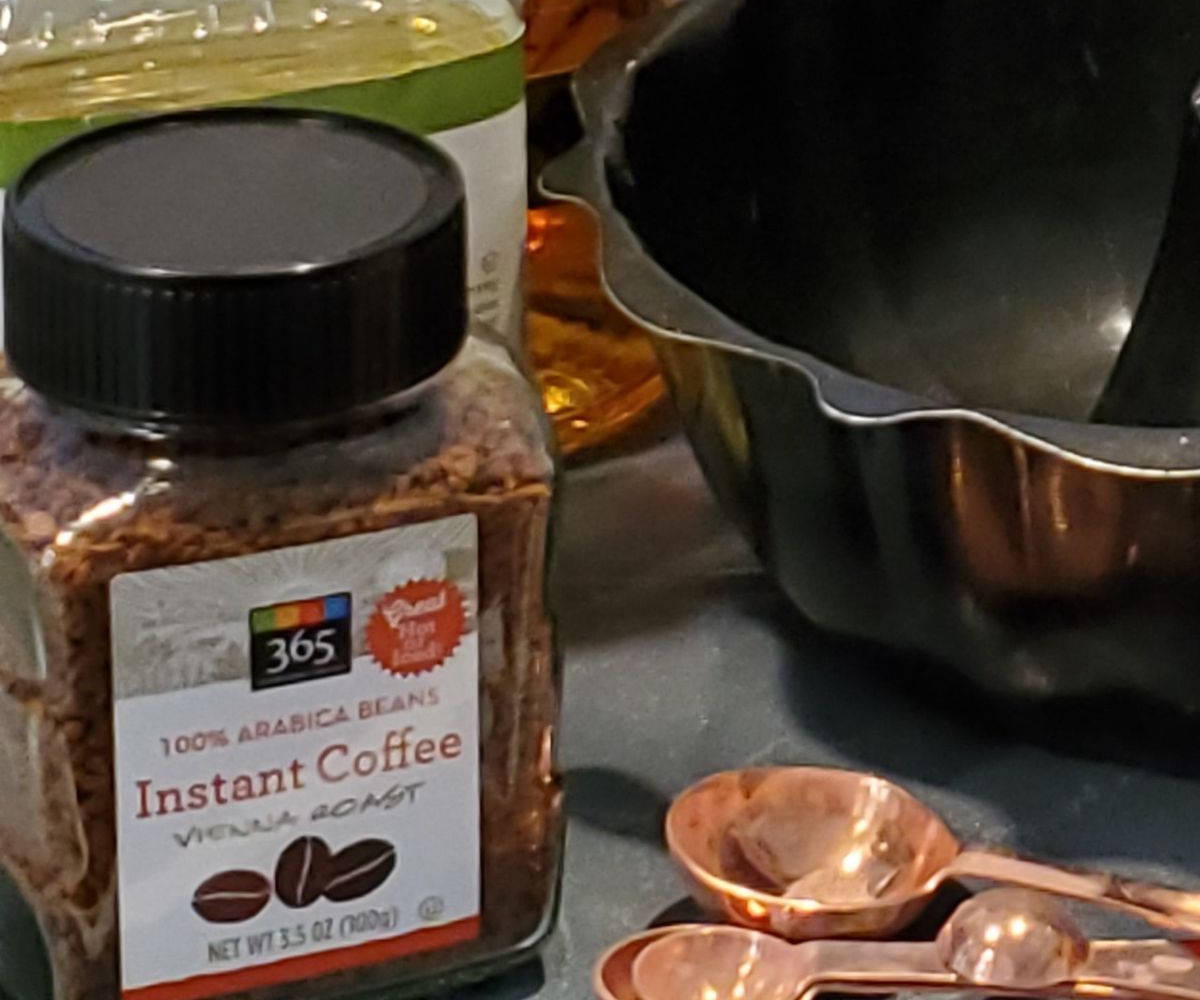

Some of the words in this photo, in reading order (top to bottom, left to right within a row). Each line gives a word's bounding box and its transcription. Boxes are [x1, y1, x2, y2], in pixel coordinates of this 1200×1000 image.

[265, 628, 338, 674] 365
[160, 728, 230, 757] 100%
[237, 705, 350, 744] ARABICA
[358, 688, 441, 720] BEANS
[136, 759, 306, 819] Instant
[316, 726, 463, 782] Coffee
[172, 810, 299, 848] VIENNA
[310, 781, 427, 822] ROAST
[207, 936, 243, 963] NET
[246, 928, 273, 955] WT
[276, 924, 307, 950] 3.5
[311, 917, 334, 943] OZ
